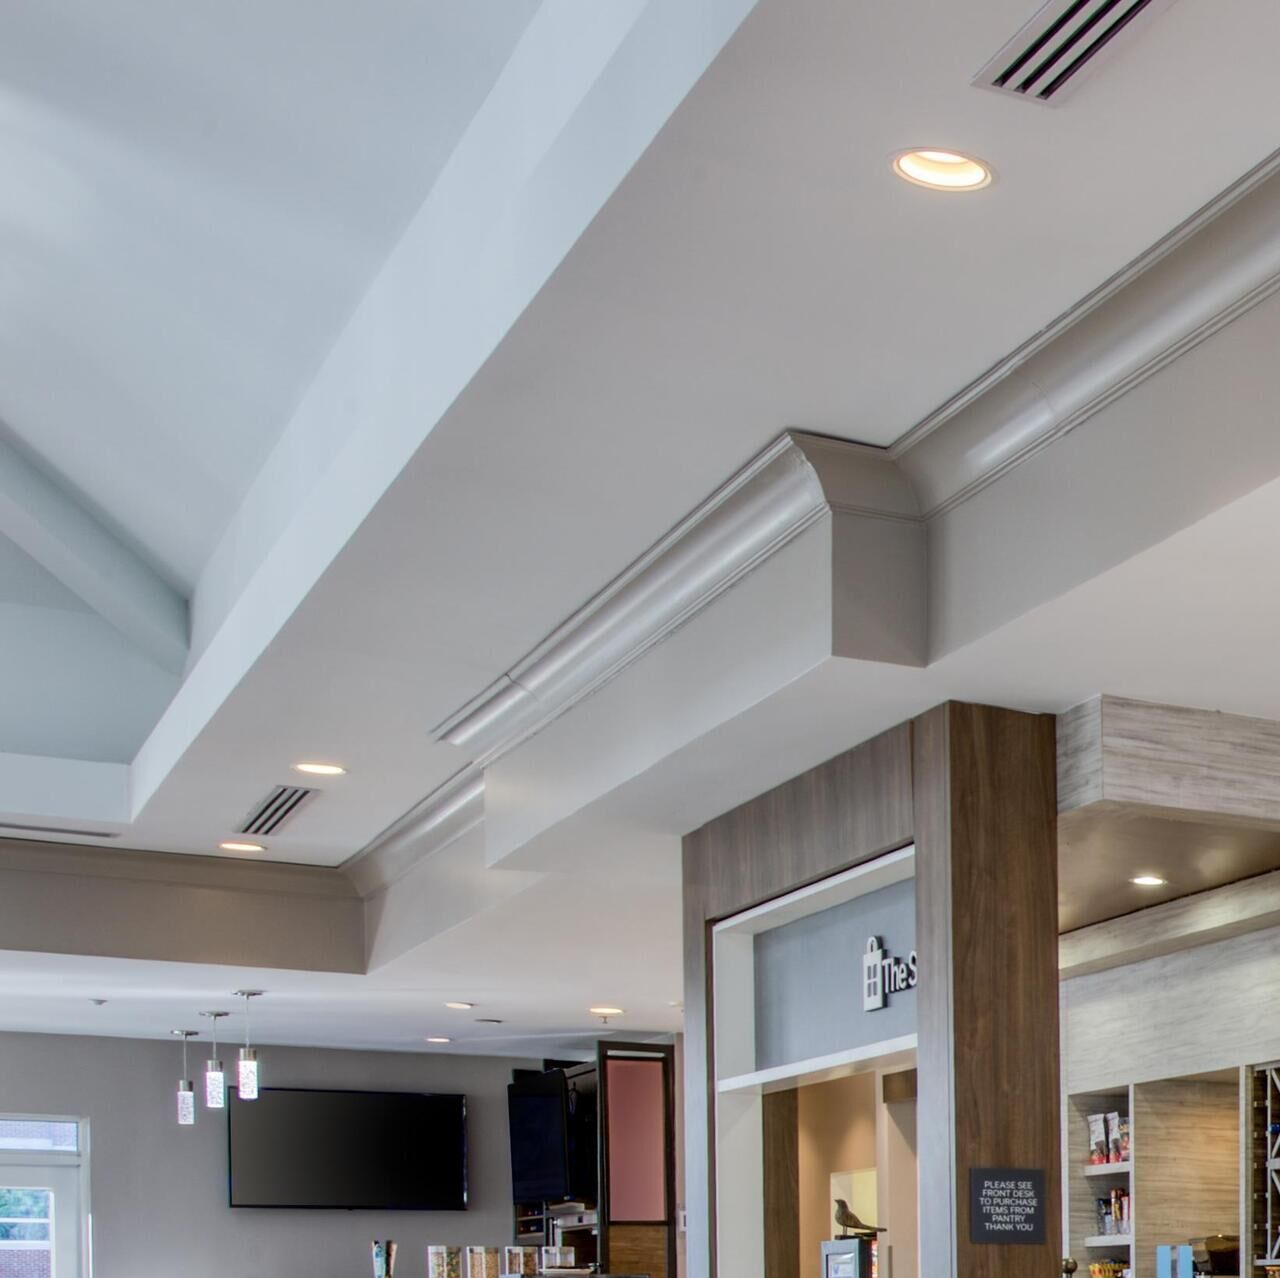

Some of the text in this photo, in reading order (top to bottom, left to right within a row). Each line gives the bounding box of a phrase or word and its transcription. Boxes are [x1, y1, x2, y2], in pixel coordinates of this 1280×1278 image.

[882, 958, 907, 993] The
[984, 1181, 1033, 1190] PLEASE SEE
[982, 1189, 1035, 1198] FRONT DESK
[979, 1197, 1038, 1207] TO PURCHASE
[983, 1206, 1034, 1215] ITEMS FROM
[991, 1215, 1026, 1223] PANTRY
[984, 1223, 1034, 1231] THANK YOU
